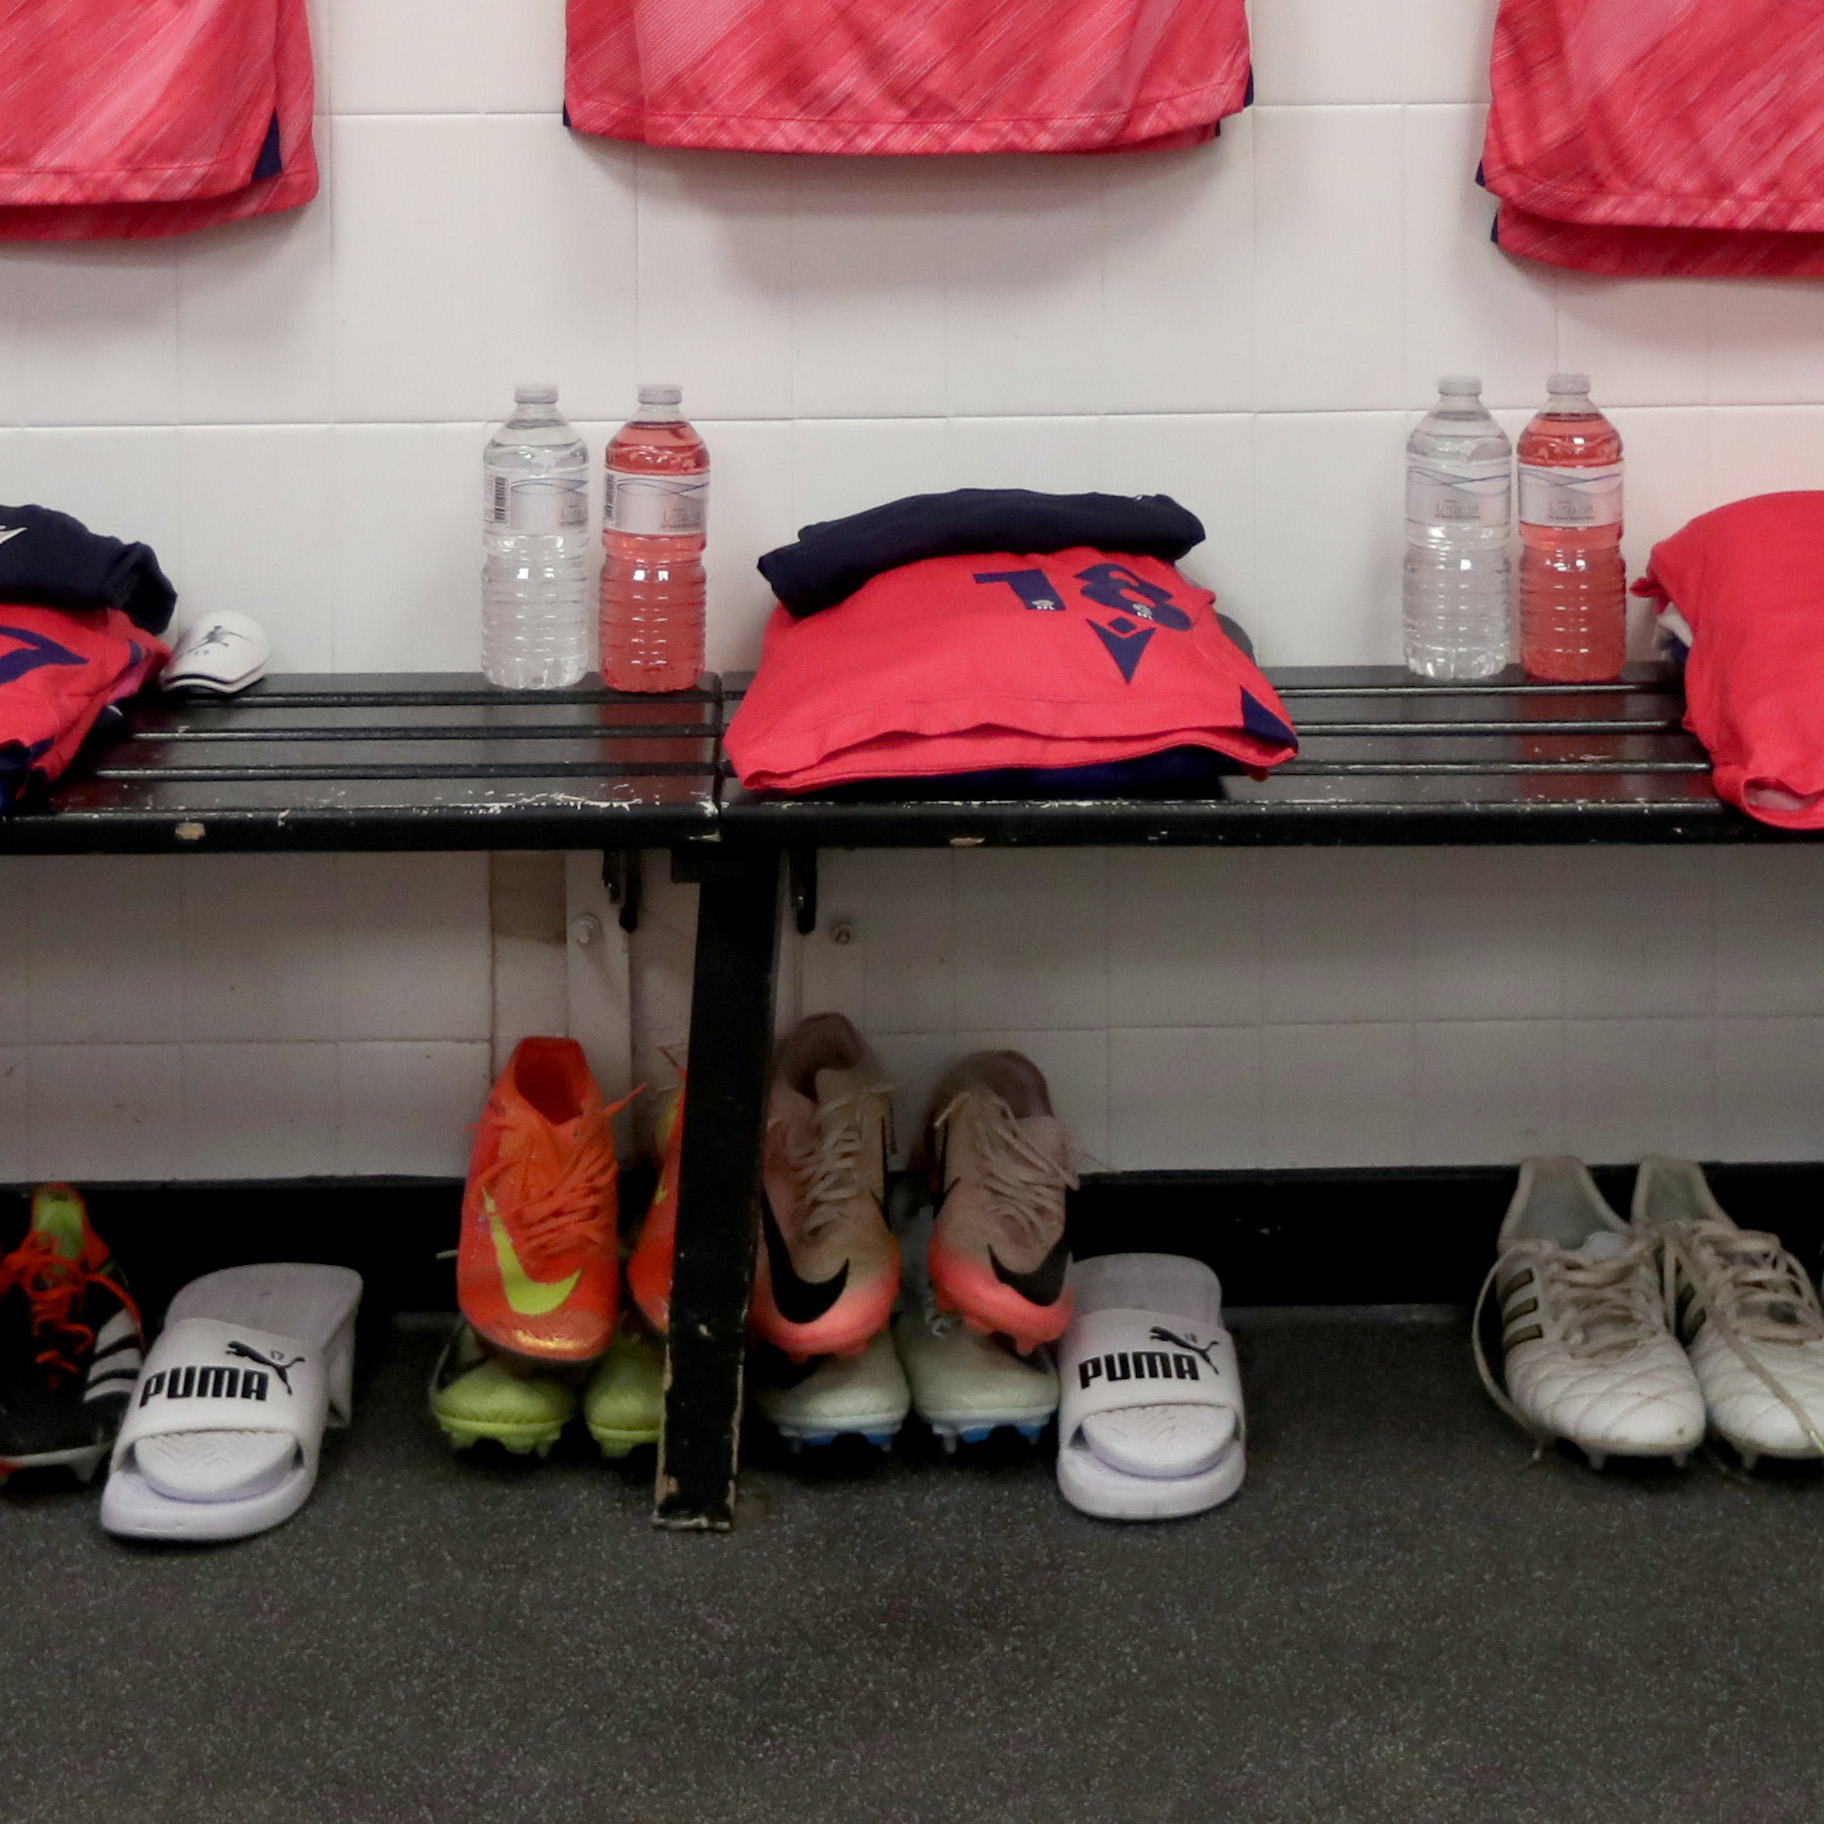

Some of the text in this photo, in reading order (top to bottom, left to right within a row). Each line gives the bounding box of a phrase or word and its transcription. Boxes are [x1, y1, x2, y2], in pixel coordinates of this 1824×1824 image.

[972, 563, 1193, 632] 18
[138, 1365, 270, 1409] PUMA
[1078, 1350, 1201, 1391] PUMA
